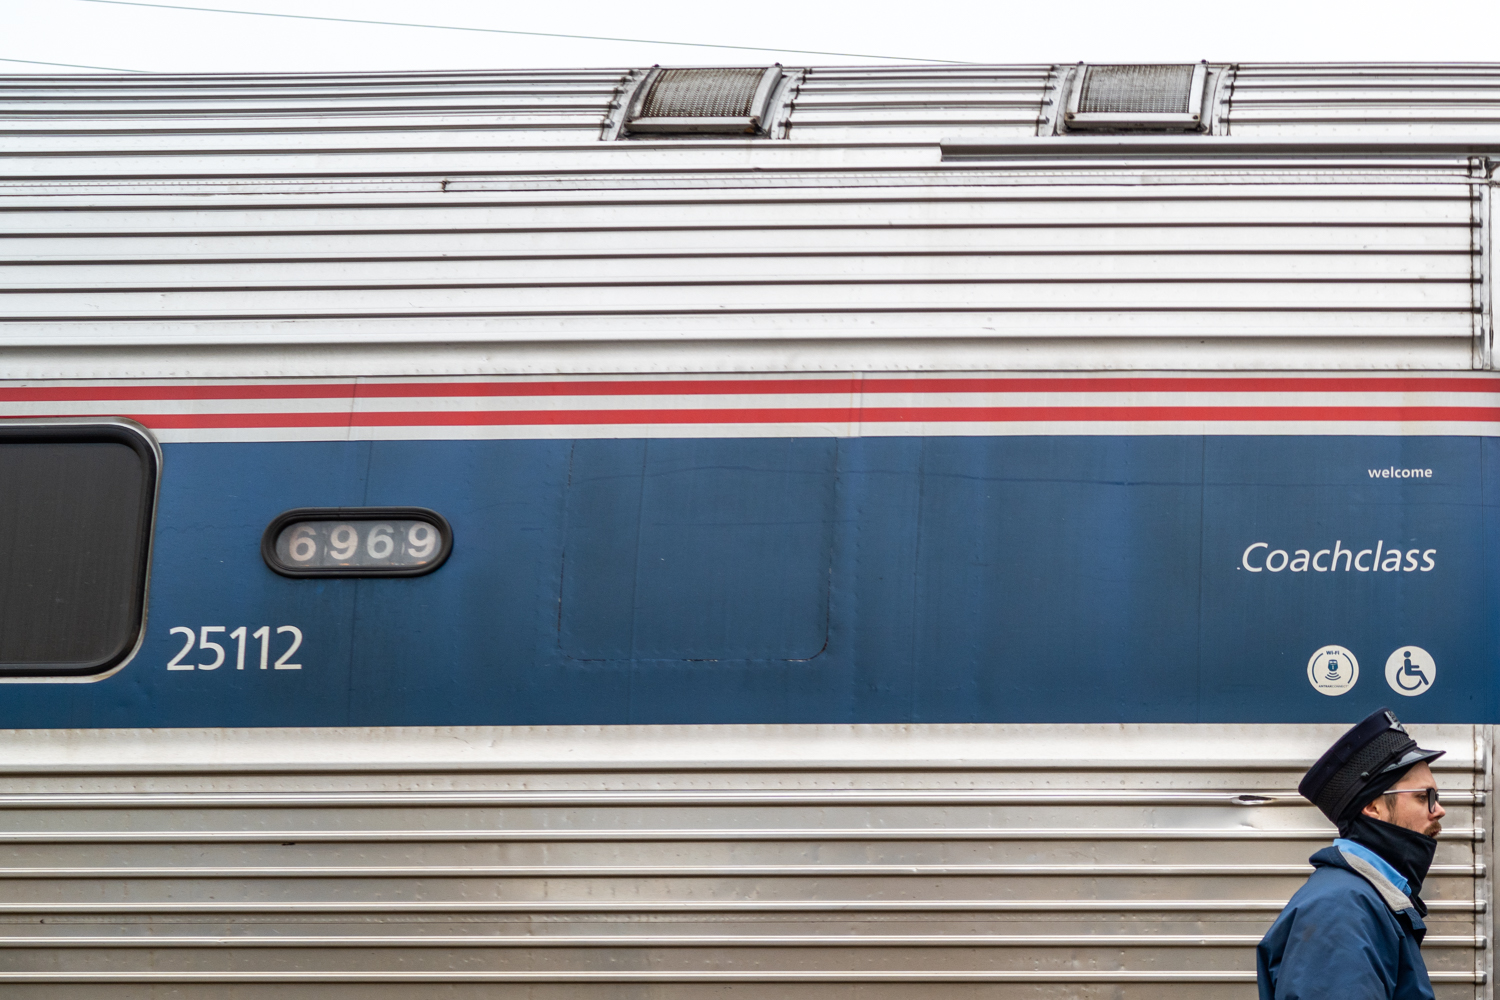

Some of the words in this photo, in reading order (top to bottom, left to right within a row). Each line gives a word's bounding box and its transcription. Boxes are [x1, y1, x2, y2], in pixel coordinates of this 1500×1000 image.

[1367, 466, 1433, 478] welcome
[289, 523, 437, 562] 6969
[1241, 540, 1437, 573] Coachclass
[166, 625, 303, 671] 25112
